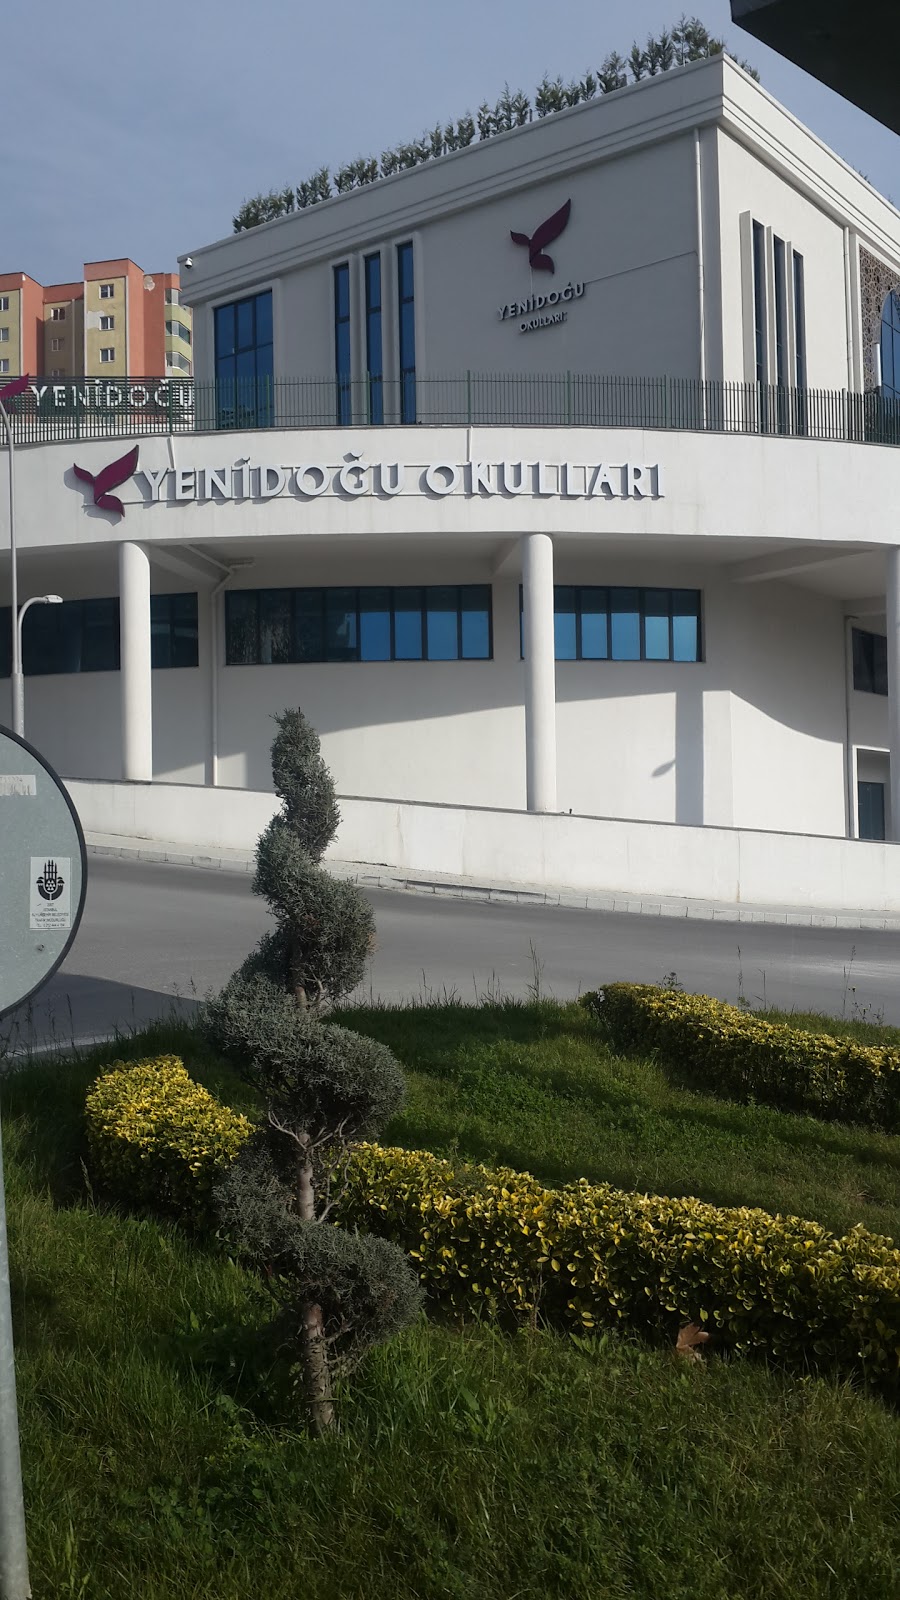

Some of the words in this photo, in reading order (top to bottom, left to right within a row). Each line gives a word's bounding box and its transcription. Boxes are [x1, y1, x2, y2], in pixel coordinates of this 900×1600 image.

[497, 281, 586, 321] YENİDOĞU
[142, 451, 406, 501] YENİDOĞU
[425, 462, 662, 498] OKULLARI
